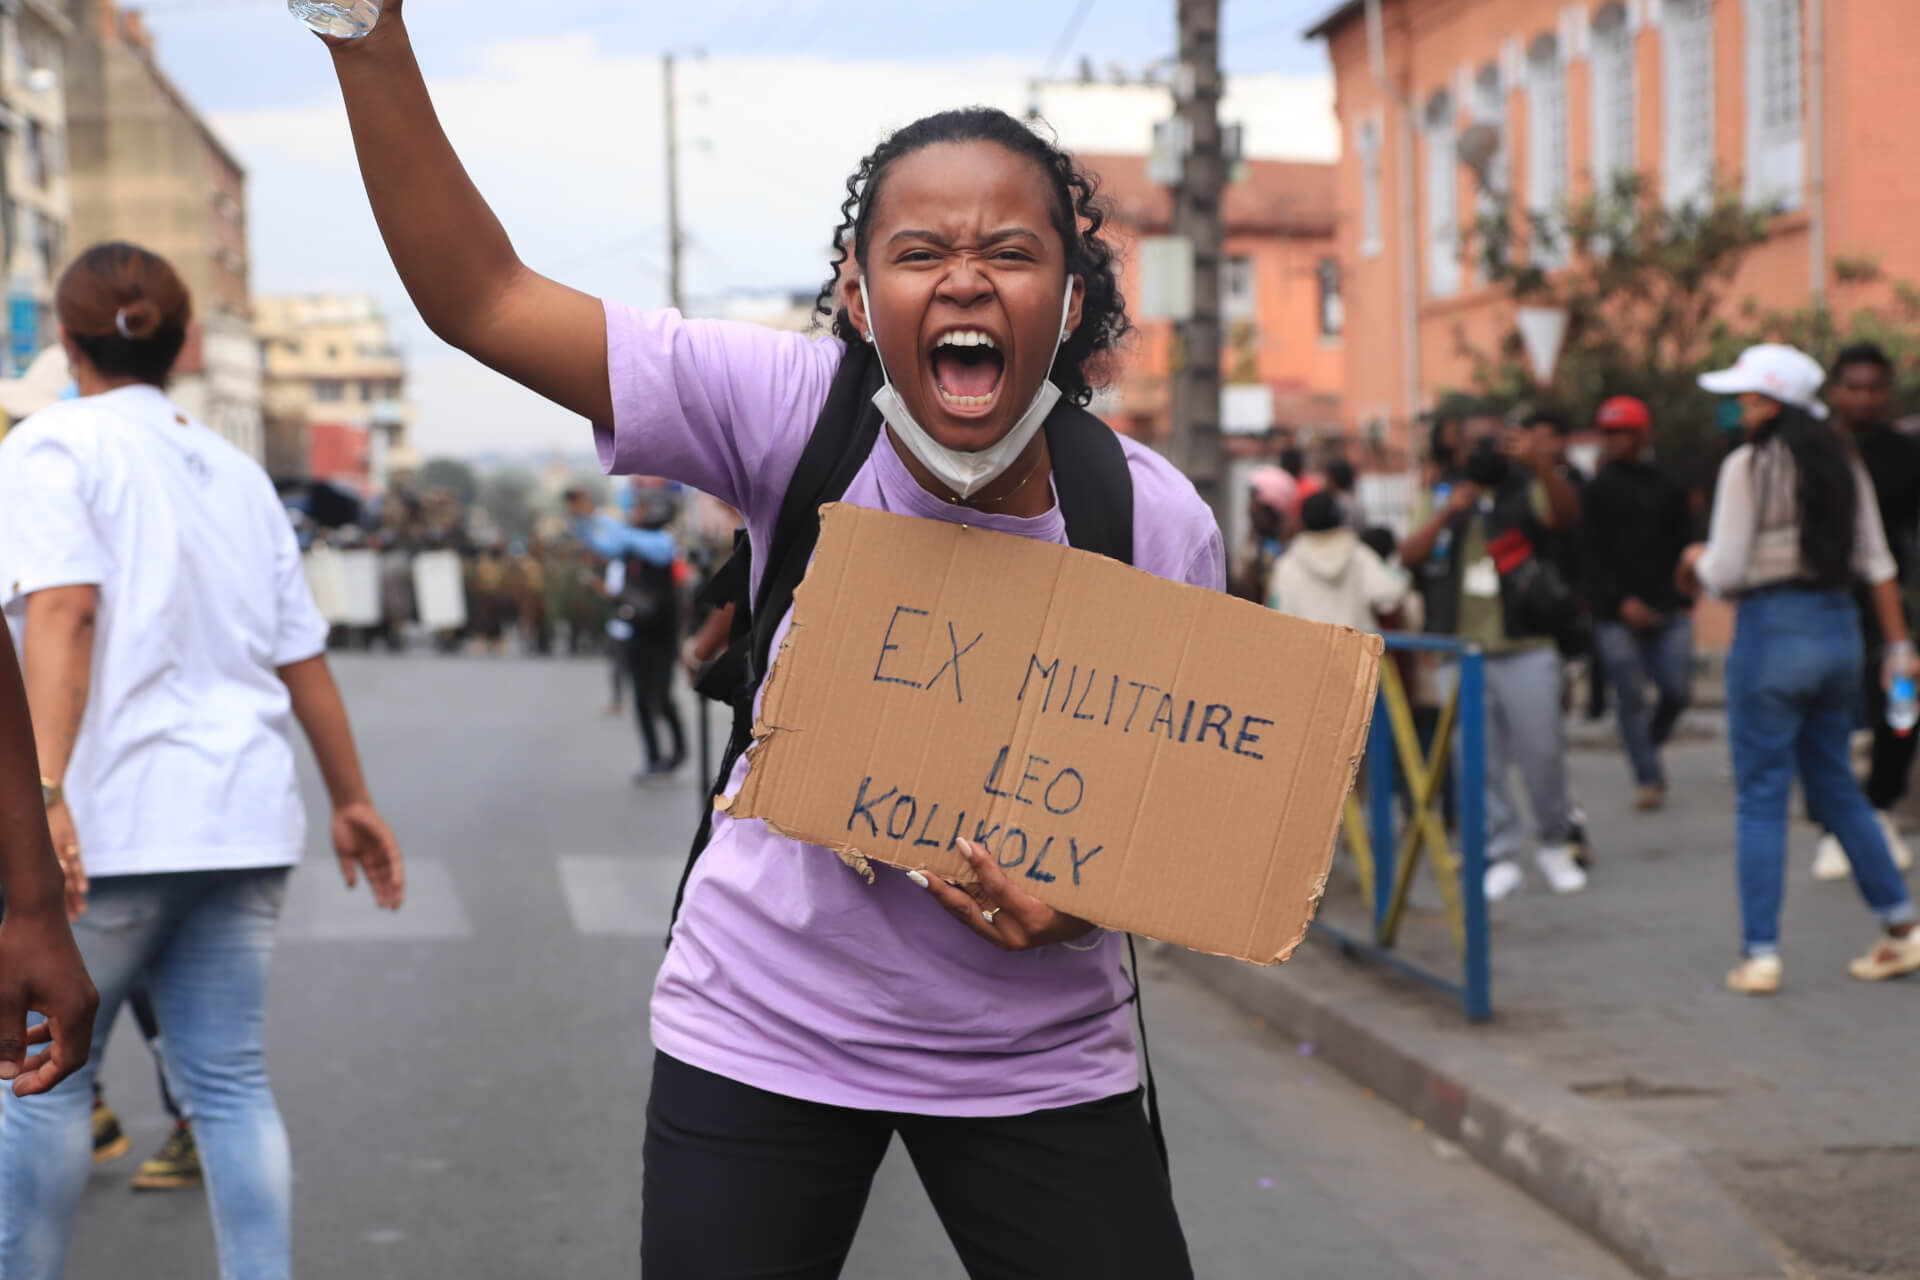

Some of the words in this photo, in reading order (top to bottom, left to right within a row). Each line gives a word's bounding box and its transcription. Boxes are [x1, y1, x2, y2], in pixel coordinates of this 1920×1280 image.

[873, 605, 984, 703] EX
[1017, 652, 1275, 760] MILITAIRE
[846, 775, 1104, 887] KOLIKOLY
[983, 744, 1084, 816] LEO
